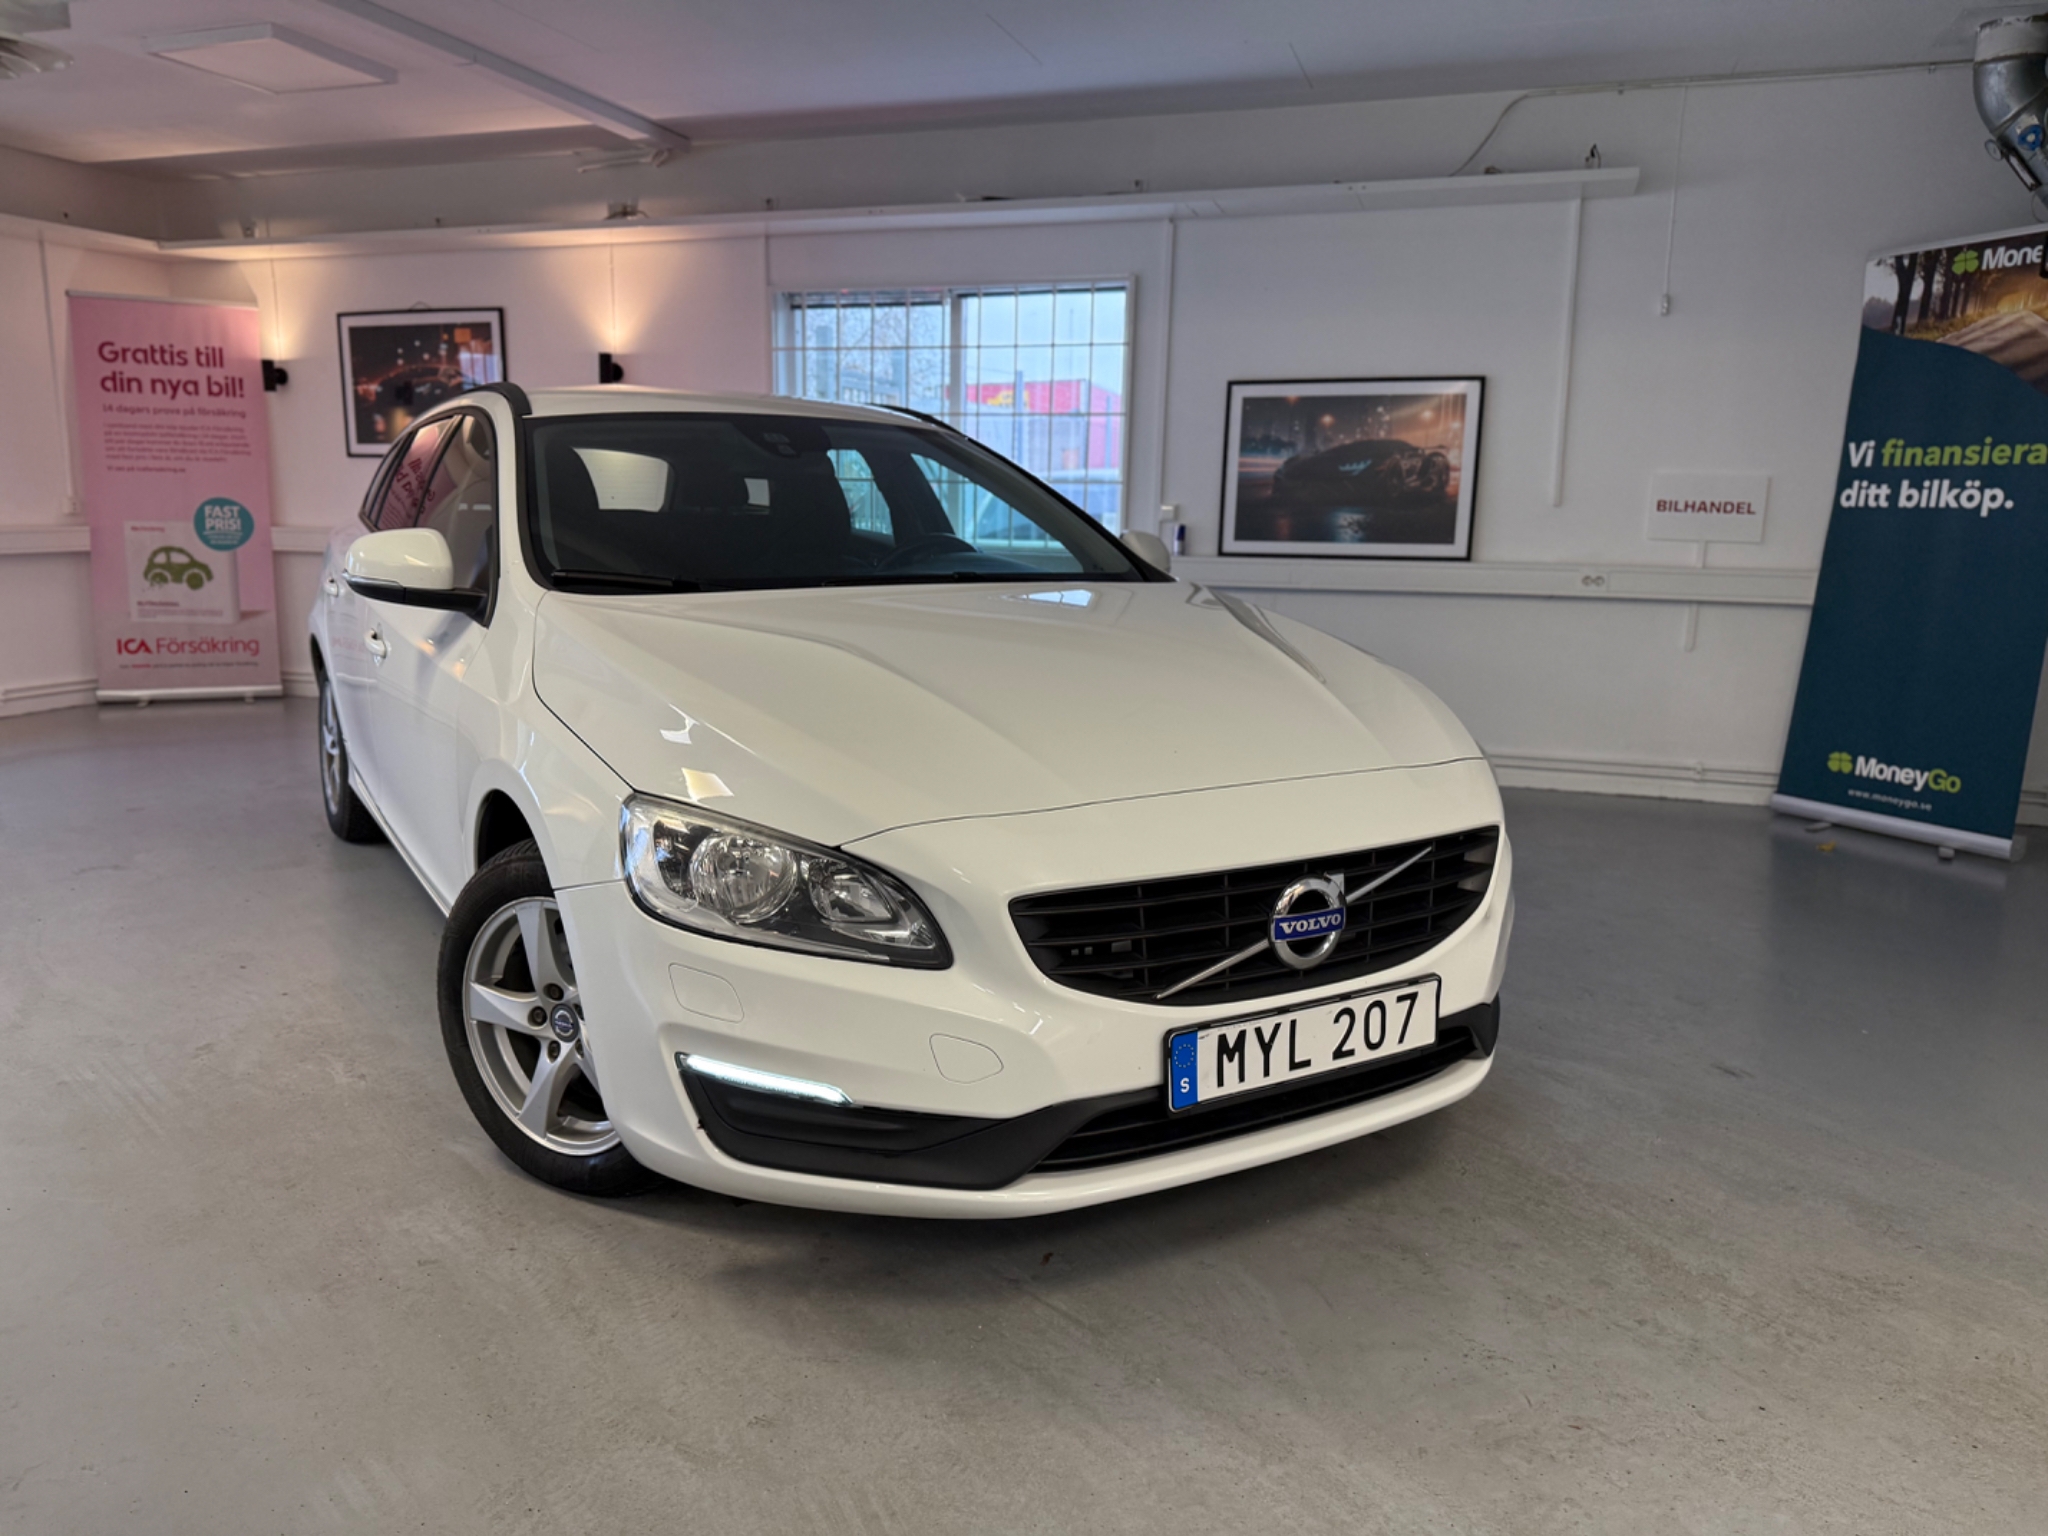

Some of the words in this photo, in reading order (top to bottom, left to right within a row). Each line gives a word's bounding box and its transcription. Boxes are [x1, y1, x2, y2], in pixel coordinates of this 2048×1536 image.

[98, 341, 188, 367] Grattis
[195, 346, 224, 368] till
[100, 371, 142, 394] din
[151, 378, 199, 400] nya
[207, 375, 245, 399] bil!
[1848, 440, 1875, 468] Vi
[1881, 436, 2048, 467] finansiera
[1656, 499, 1756, 515] BILHANDEL
[1839, 480, 1891, 508] ditt
[1898, 479, 2014, 517] bilköp.
[204, 505, 240, 518] FAST
[205, 518, 241, 531] PRIS!
[116, 638, 153, 655] ICA
[156, 636, 260, 657] Försäkring
[1854, 755, 1961, 794] MoneyGo
[1848, 788, 1932, 811] www.moneygo.se
[1279, 912, 1342, 935] VOLVO
[1217, 1019, 1312, 1088] MYL
[1332, 991, 1419, 1061] 207
[1180, 1077, 1190, 1093] S
